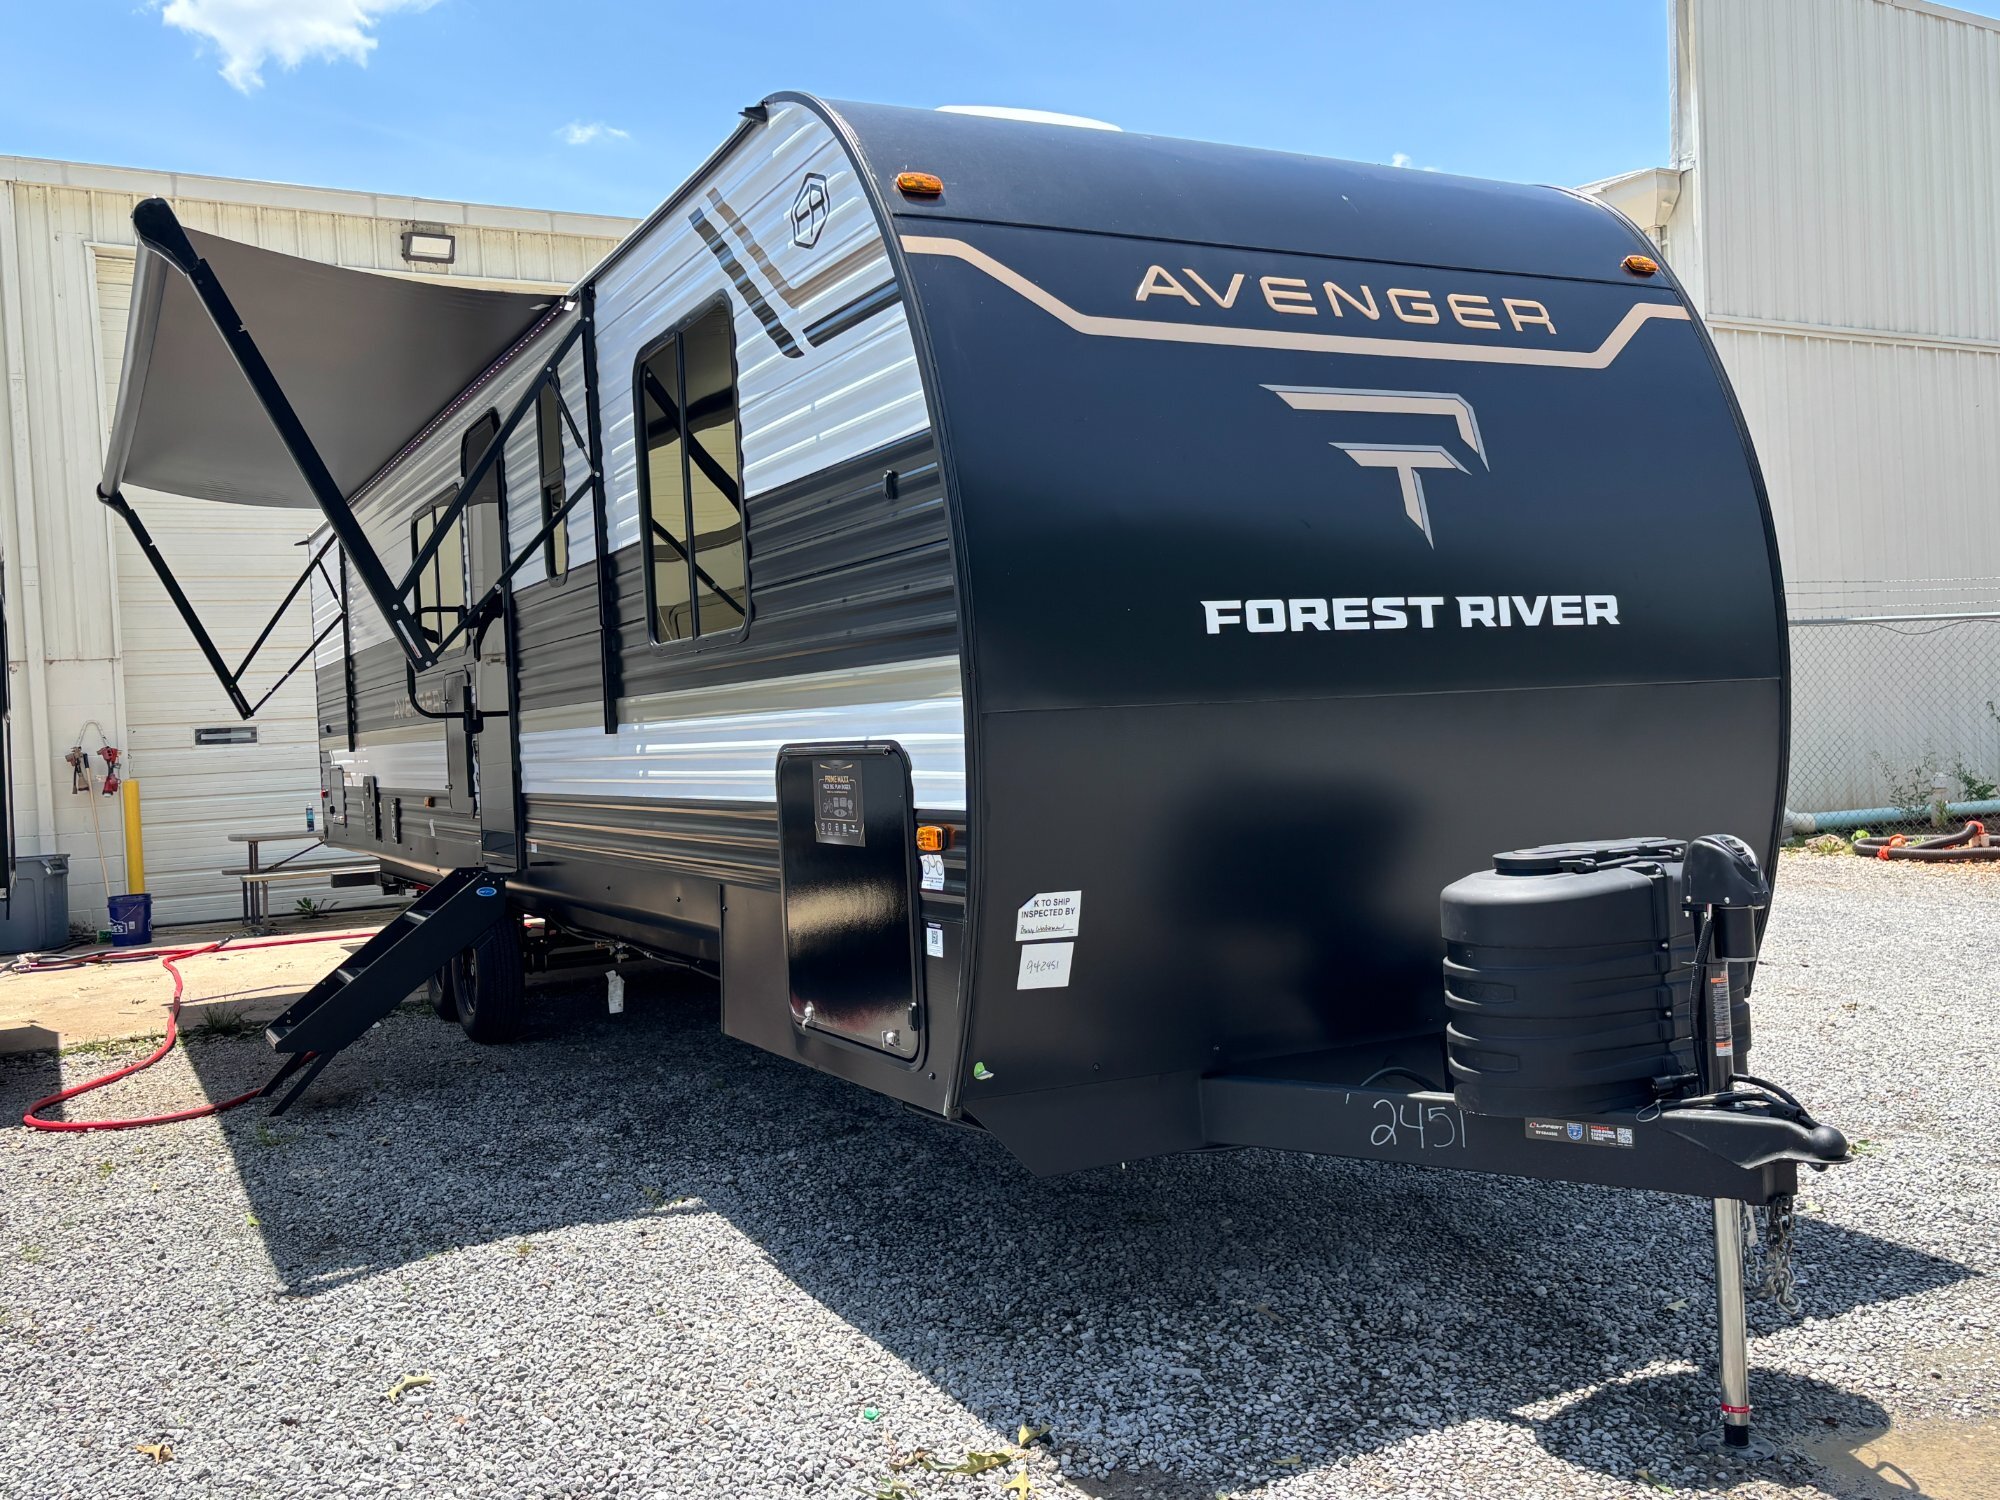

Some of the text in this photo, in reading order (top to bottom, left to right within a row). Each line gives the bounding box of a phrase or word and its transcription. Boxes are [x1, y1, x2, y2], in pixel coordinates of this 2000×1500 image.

[1135, 265, 1557, 334] AVENGER
[1201, 594, 1620, 634] FOREST RIVER
[1022, 908, 1064, 918] INSPECTED
[1370, 1099, 1466, 1149] 2451
